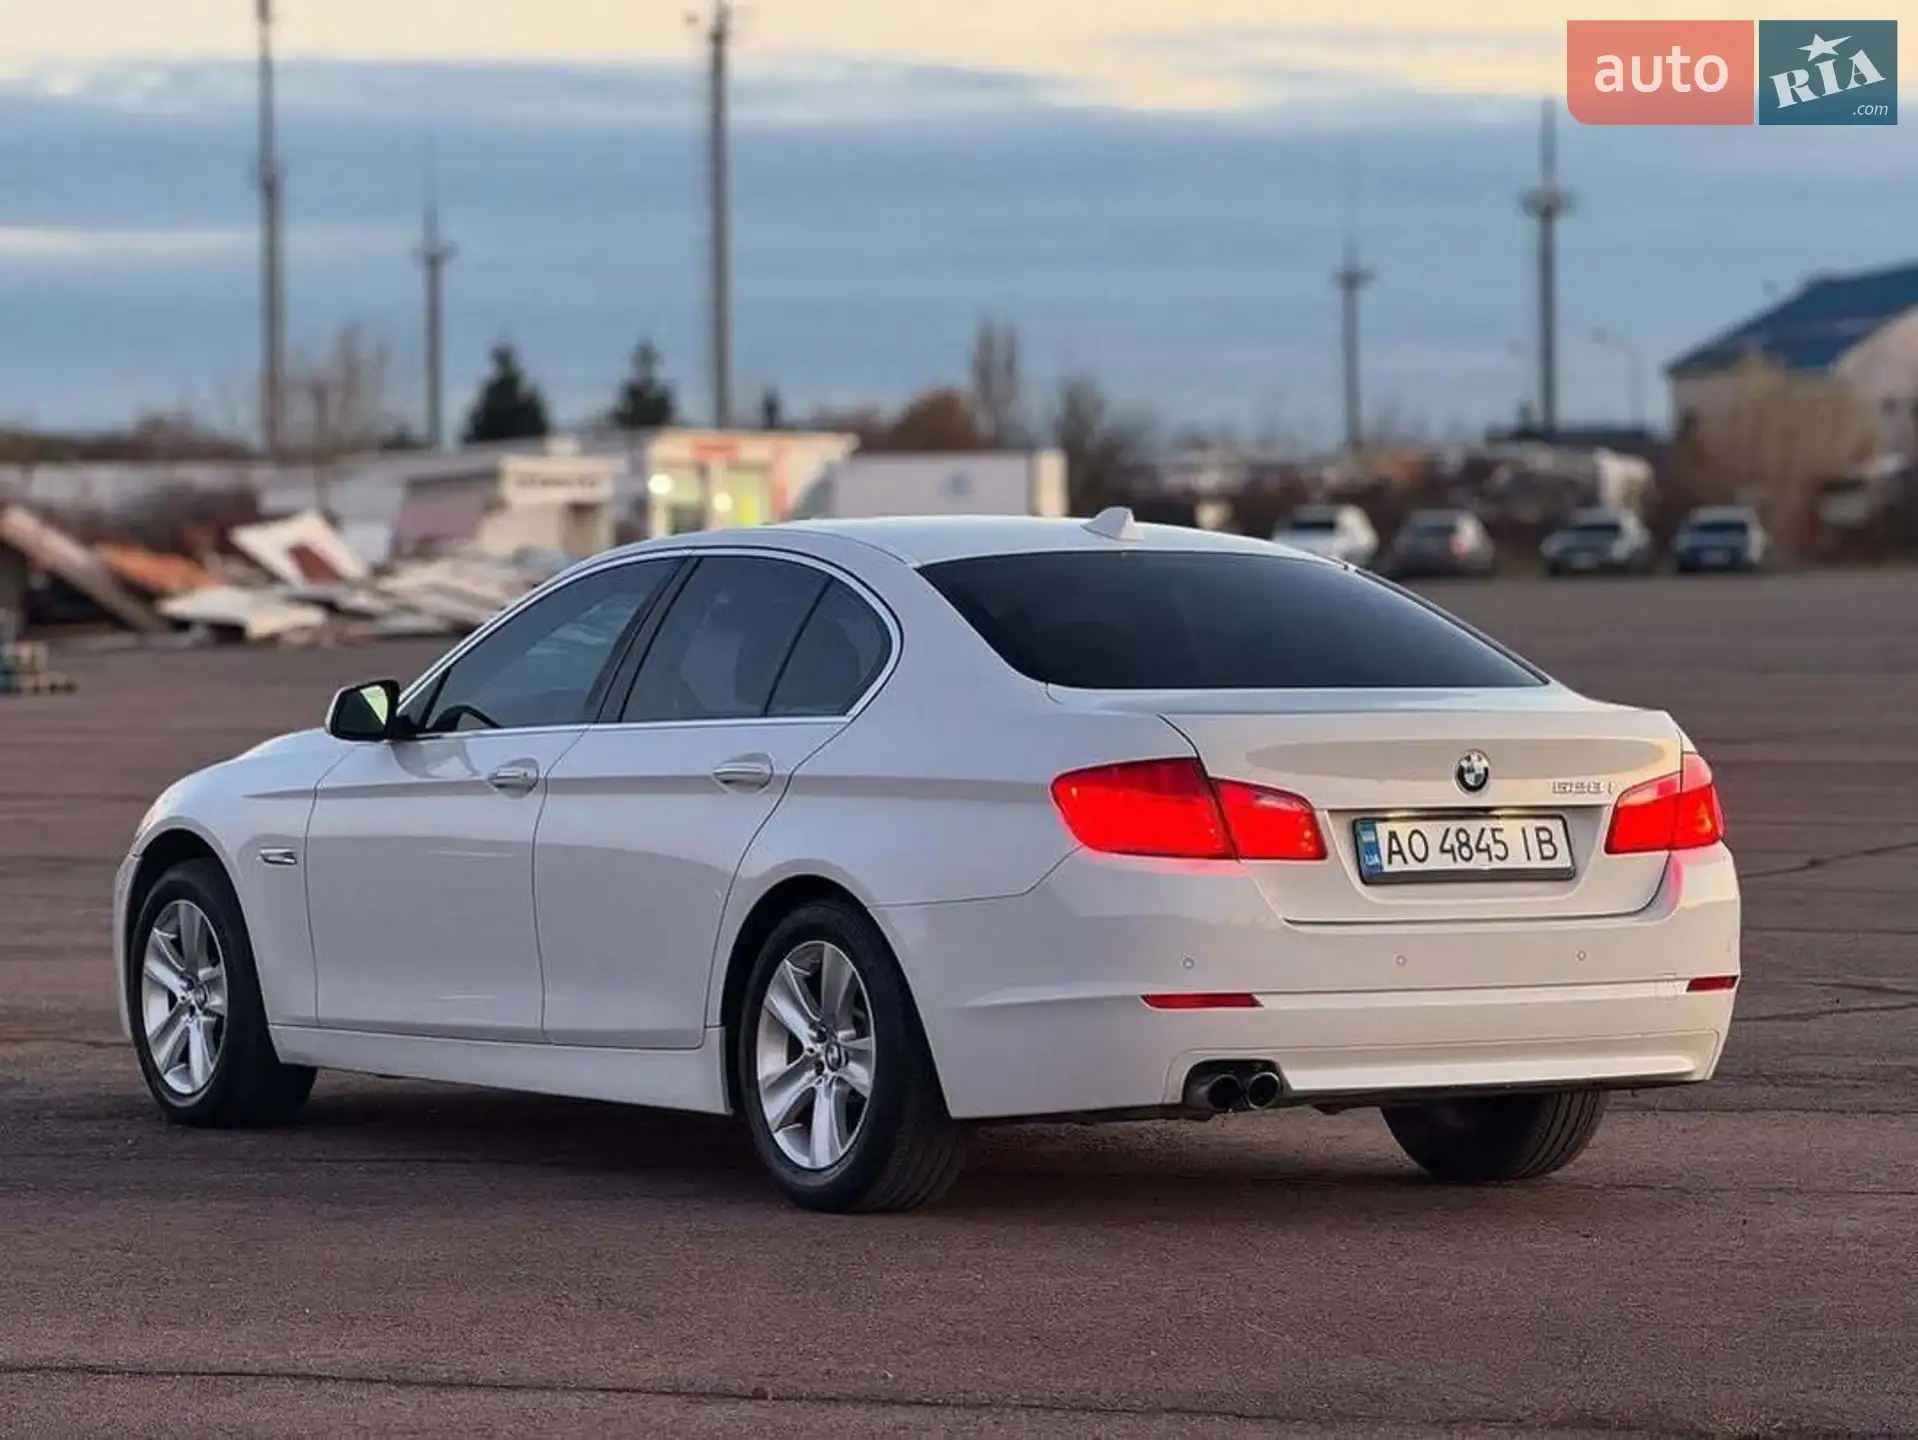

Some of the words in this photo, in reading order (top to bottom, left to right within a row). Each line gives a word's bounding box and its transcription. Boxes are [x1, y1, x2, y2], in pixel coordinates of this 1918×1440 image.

[1386, 828, 1429, 866] AO
[1439, 827, 1509, 864] 4845
[1521, 826, 1558, 861] IB
